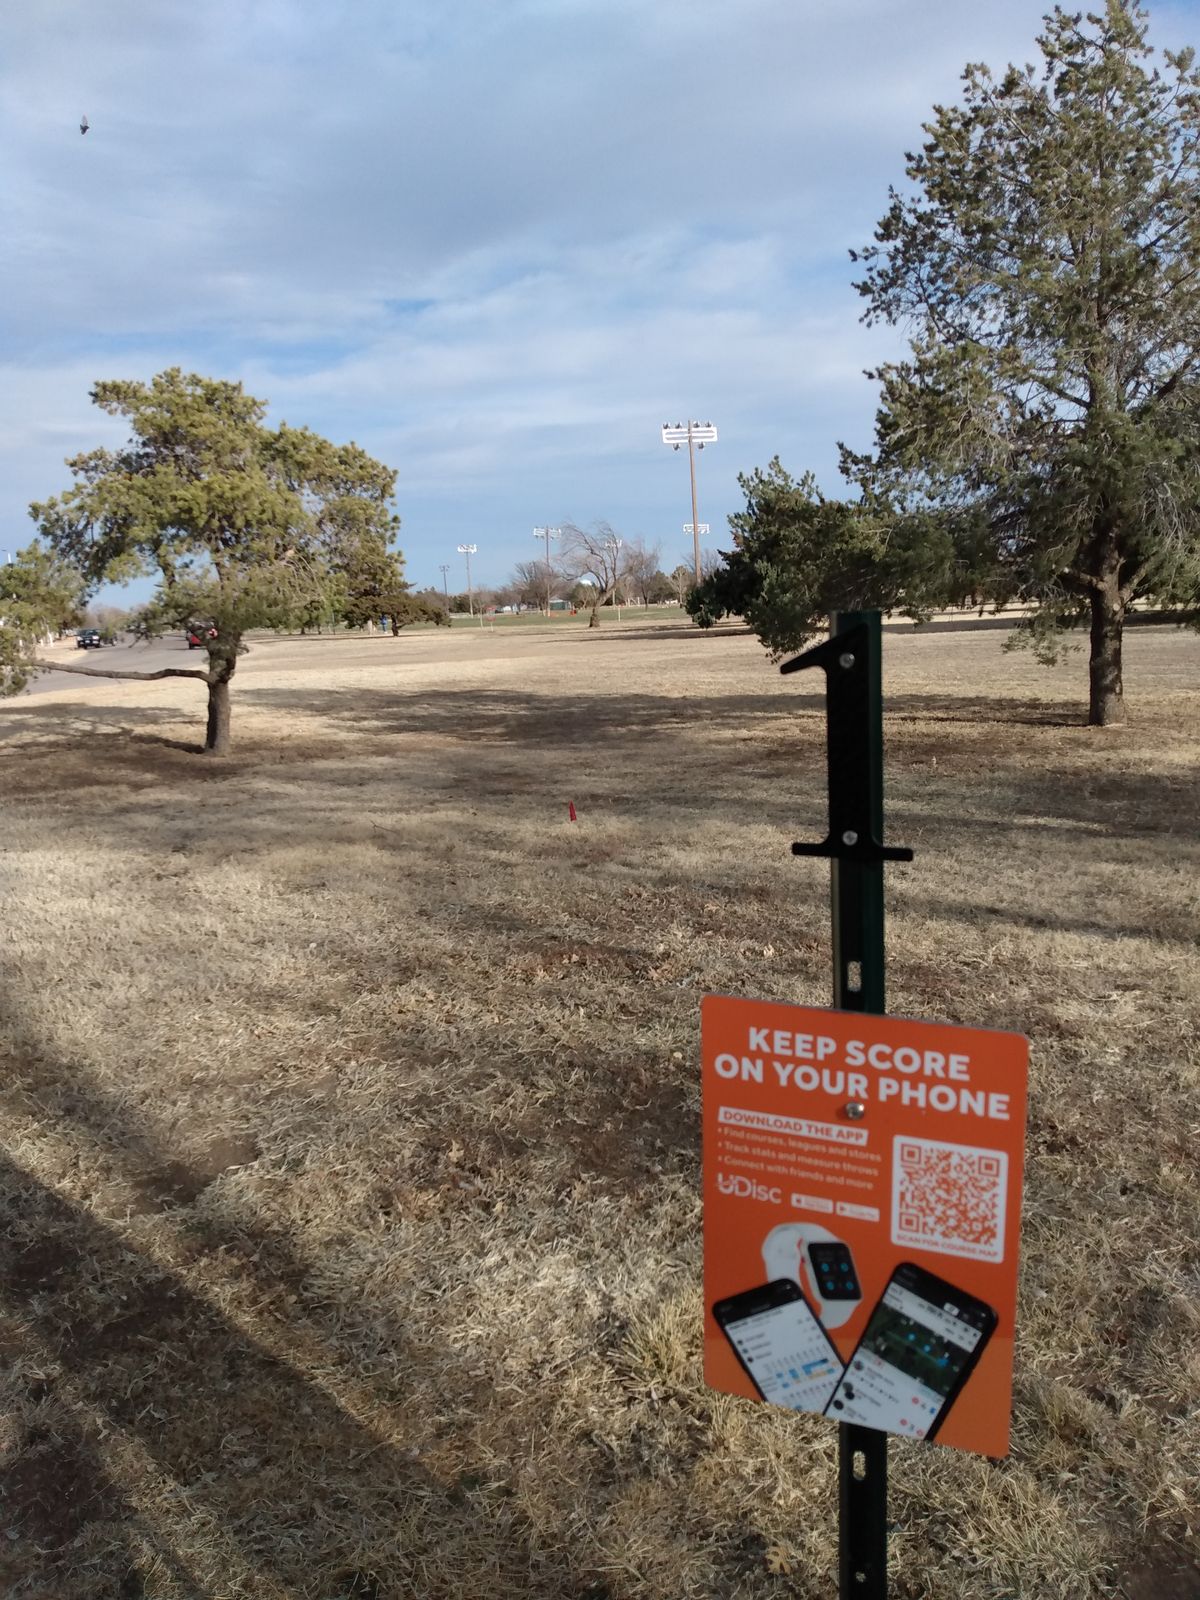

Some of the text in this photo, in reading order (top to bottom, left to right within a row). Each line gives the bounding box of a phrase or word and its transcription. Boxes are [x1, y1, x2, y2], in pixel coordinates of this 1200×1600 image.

[780, 622, 913, 861] 1
[748, 1026, 970, 1082] KEEP SCORE
[714, 1053, 1010, 1120] ON YOUR PHONE
[723, 1110, 864, 1141] DOWNLOAD THE APP
[724, 1127, 745, 1139] Find
[788, 1137, 826, 1153] leagues
[828, 1144, 847, 1156] and
[848, 1148, 881, 1162] stores
[724, 1141, 879, 1176] Track stats and measure throws
[717, 1172, 782, 1204] UDisc
[724, 1155, 874, 1190] Connect with friends and more
